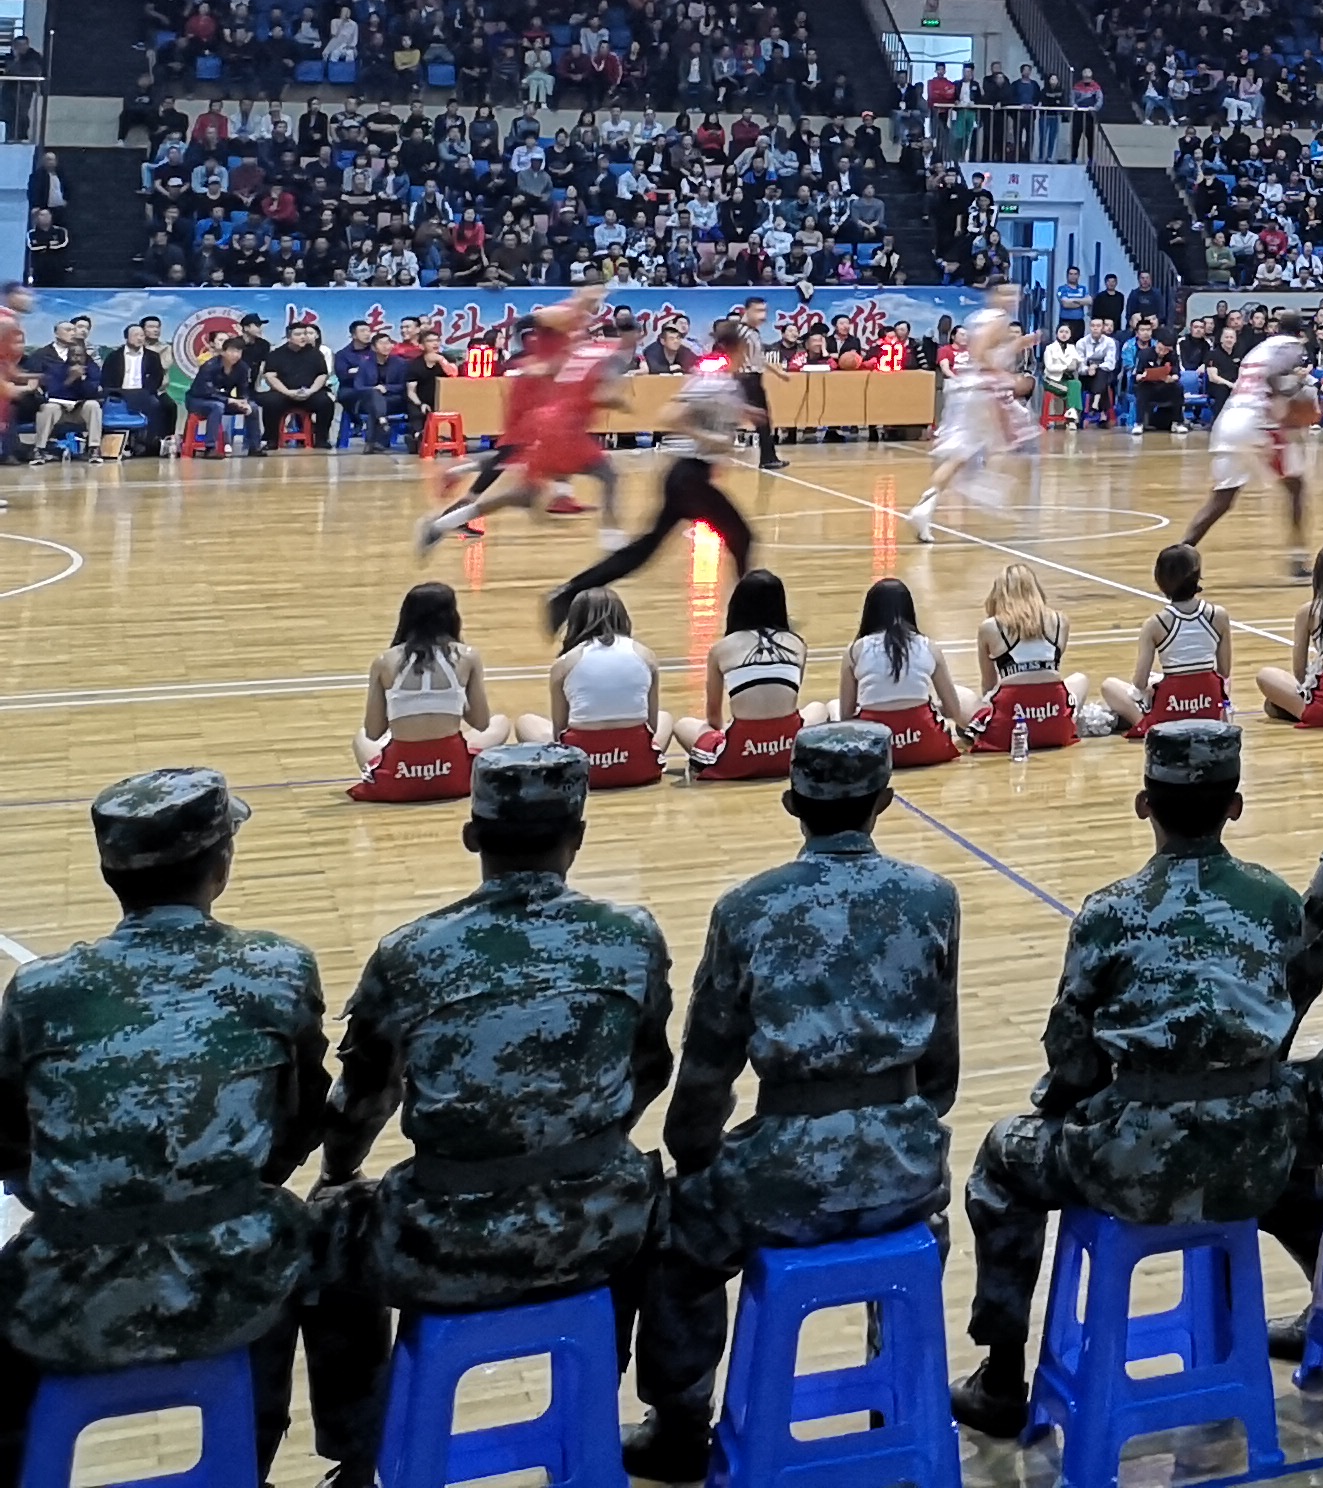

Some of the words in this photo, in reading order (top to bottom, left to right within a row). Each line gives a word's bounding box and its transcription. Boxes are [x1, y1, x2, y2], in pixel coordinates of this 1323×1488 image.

[880, 344, 904, 372] 22
[1012, 701, 1060, 723] Angle
[1166, 694, 1212, 714] Angle
[741, 735, 794, 756] Angle
[589, 747, 629, 769] ngle
[394, 758, 452, 781] Angle
